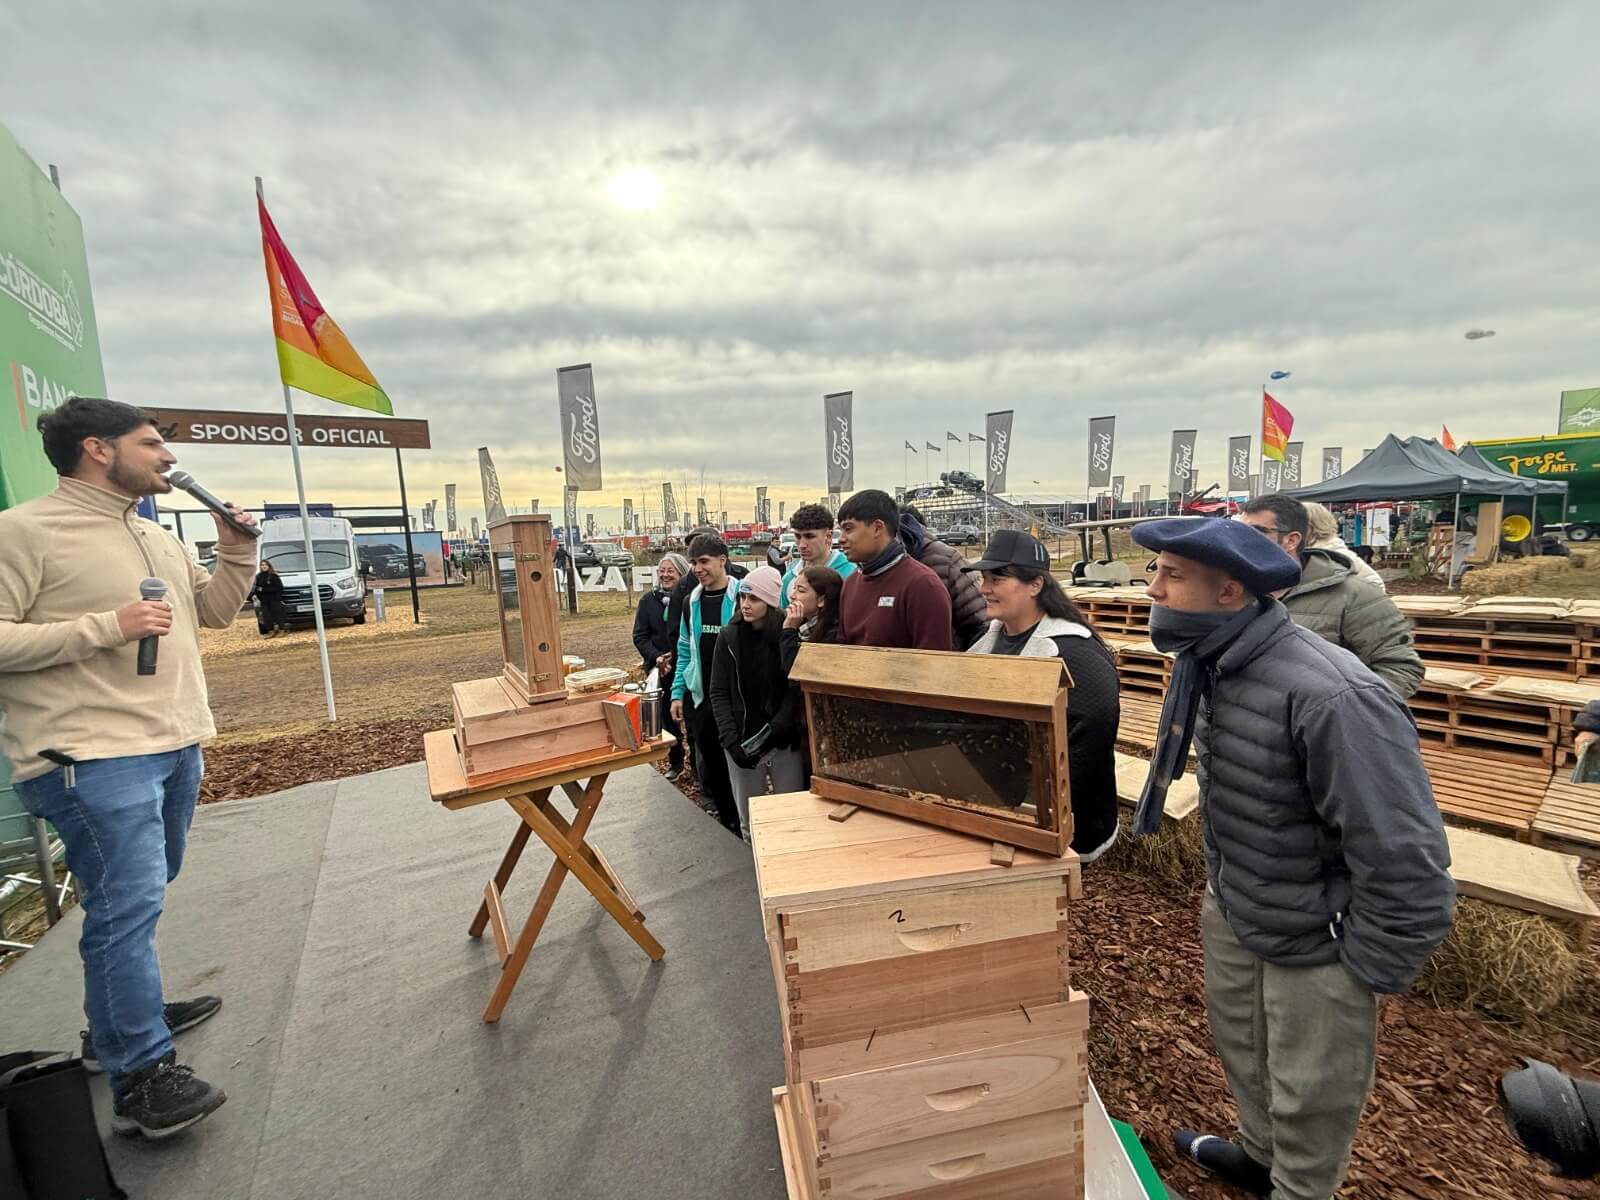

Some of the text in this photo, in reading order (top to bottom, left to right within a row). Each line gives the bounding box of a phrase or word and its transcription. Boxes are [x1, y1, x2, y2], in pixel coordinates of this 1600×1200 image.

[21, 364, 76, 410] BAN
[312, 428, 391, 444] OFICIAL
[570, 395, 597, 464] Ford
[832, 416, 851, 470] Ford
[989, 430, 1008, 475] Ford
[1092, 433, 1111, 471] Ford
[1174, 444, 1192, 479] Ford
[1231, 448, 1248, 480] Ford
[1283, 454, 1299, 482] Ford
[1265, 467, 1278, 489] Ford
[887, 909, 906, 924] 2
